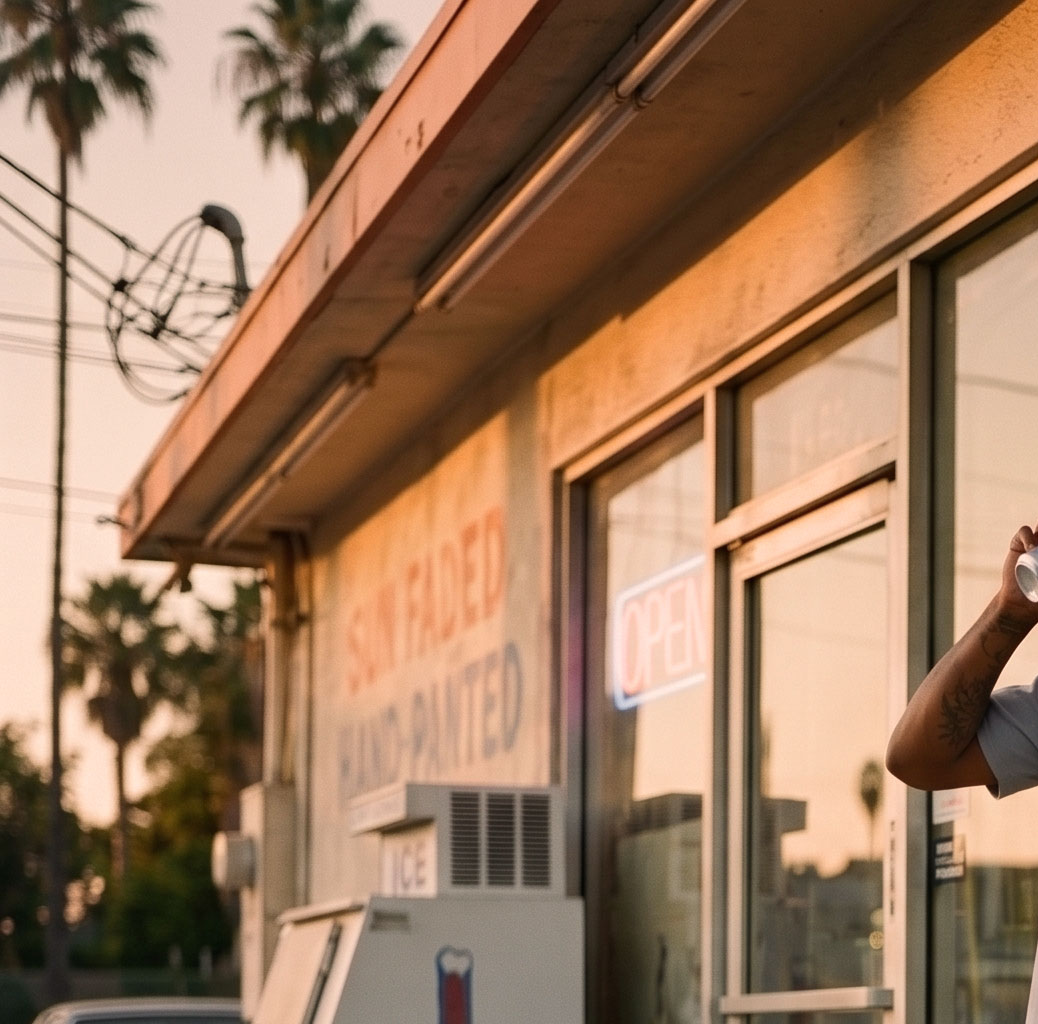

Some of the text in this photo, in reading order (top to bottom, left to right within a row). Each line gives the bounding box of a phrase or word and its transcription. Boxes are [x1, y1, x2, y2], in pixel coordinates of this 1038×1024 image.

[405, 506, 506, 663] FADED
[622, 577, 707, 694] OPEN
[392, 842, 426, 894] ICE
